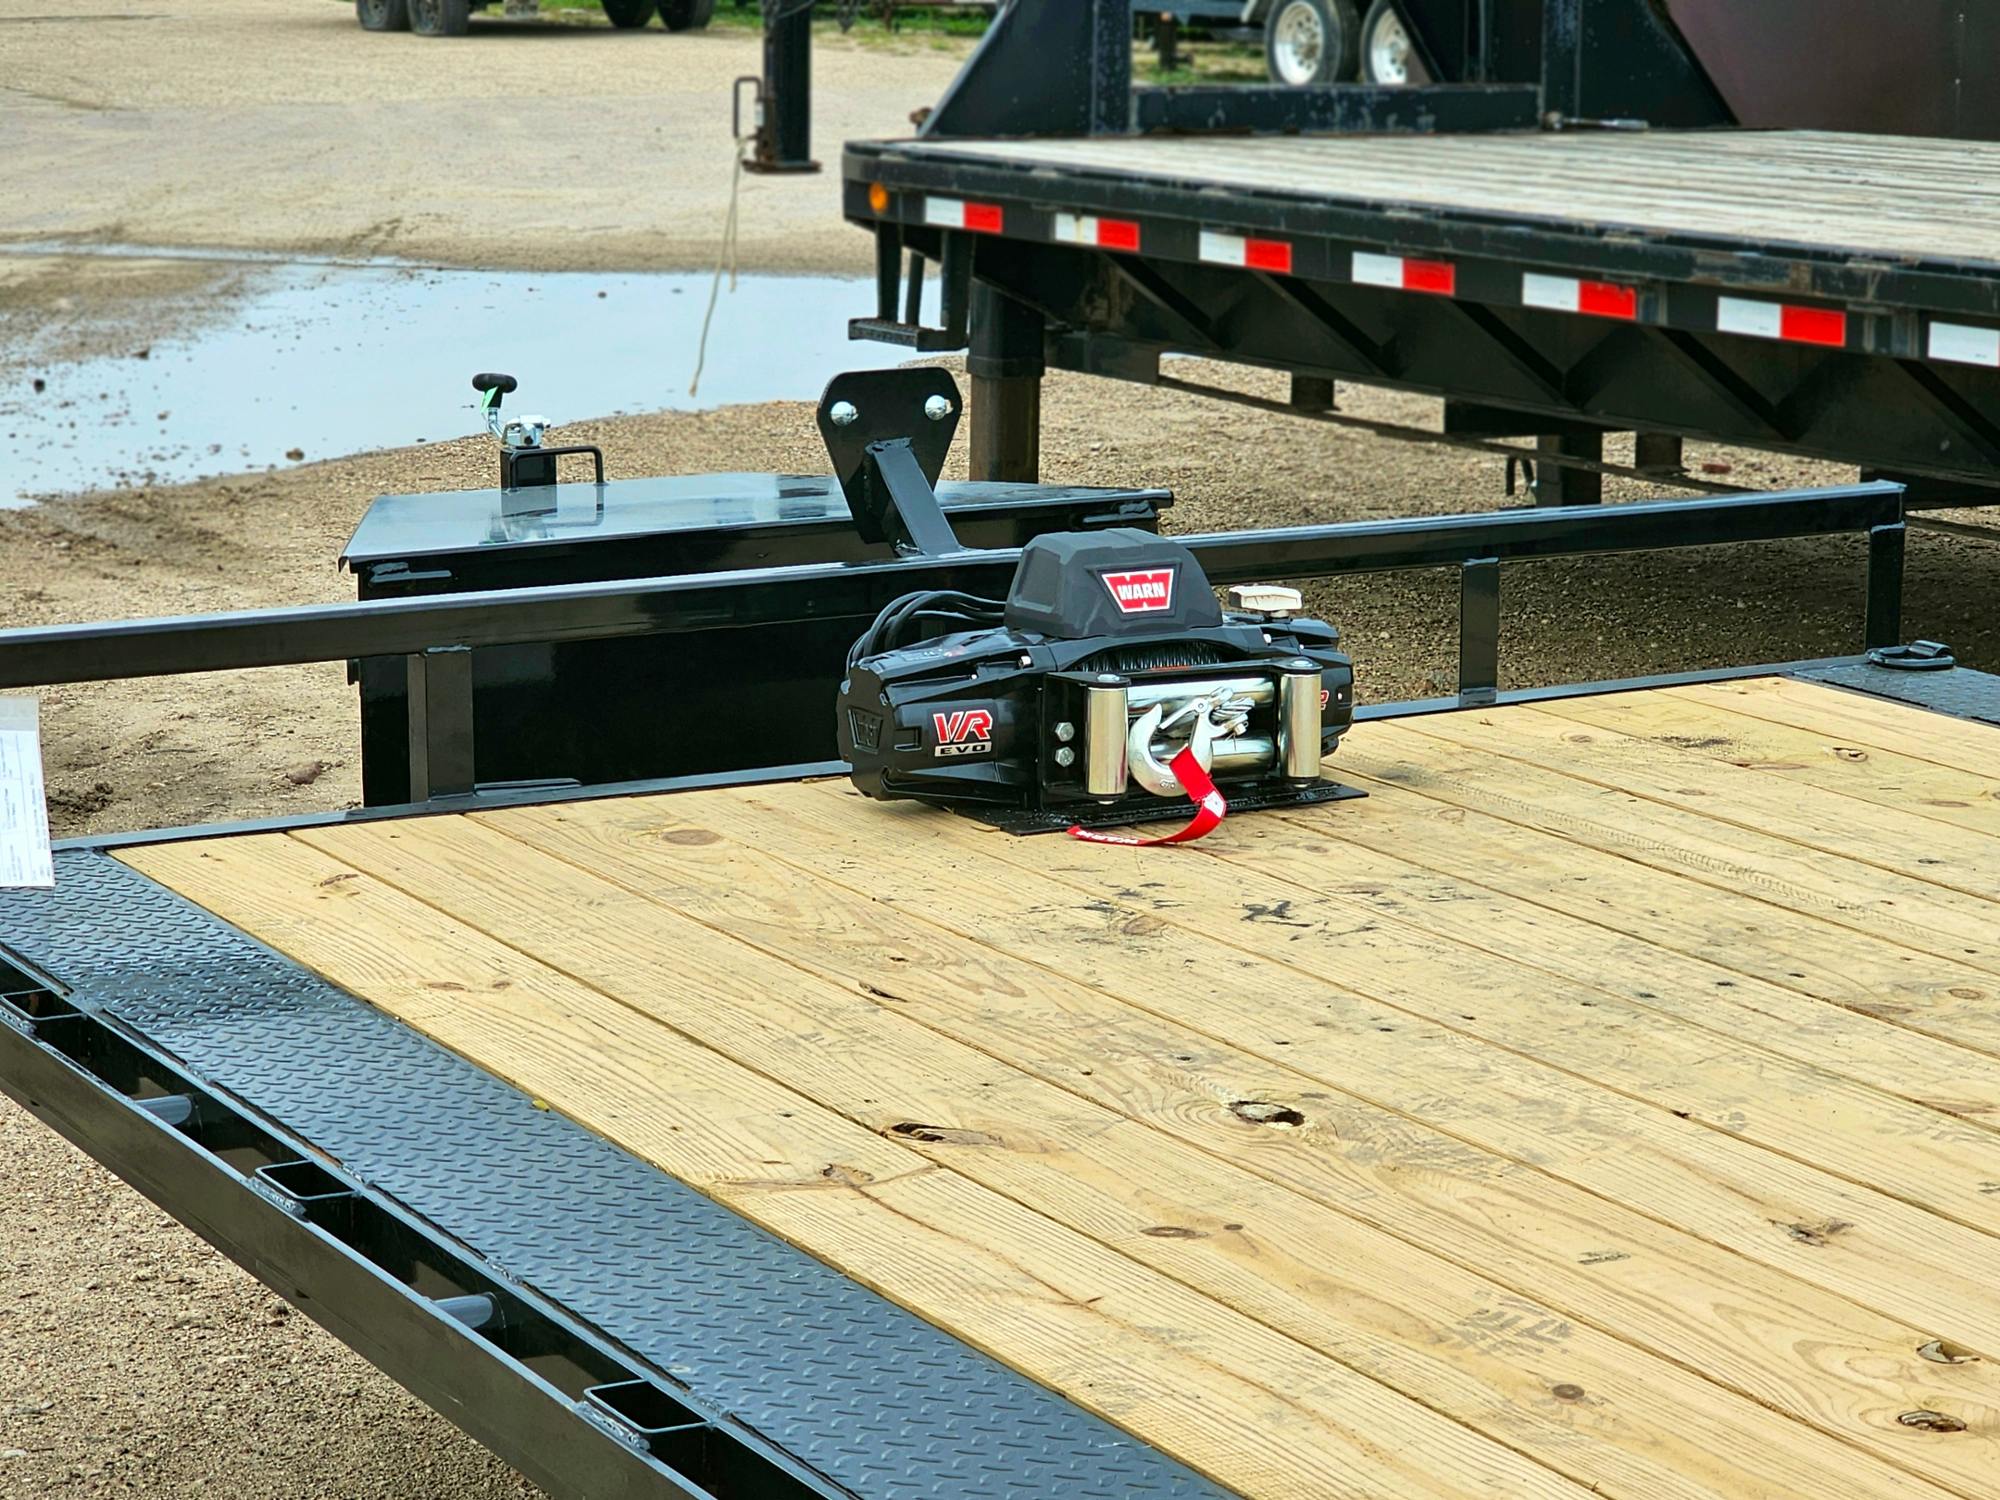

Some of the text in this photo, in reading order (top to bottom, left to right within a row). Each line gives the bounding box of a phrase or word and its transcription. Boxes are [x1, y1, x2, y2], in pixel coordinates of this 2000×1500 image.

[1117, 582, 1166, 601] WARN
[933, 709, 993, 744] VR
[940, 744, 986, 755] EVO
